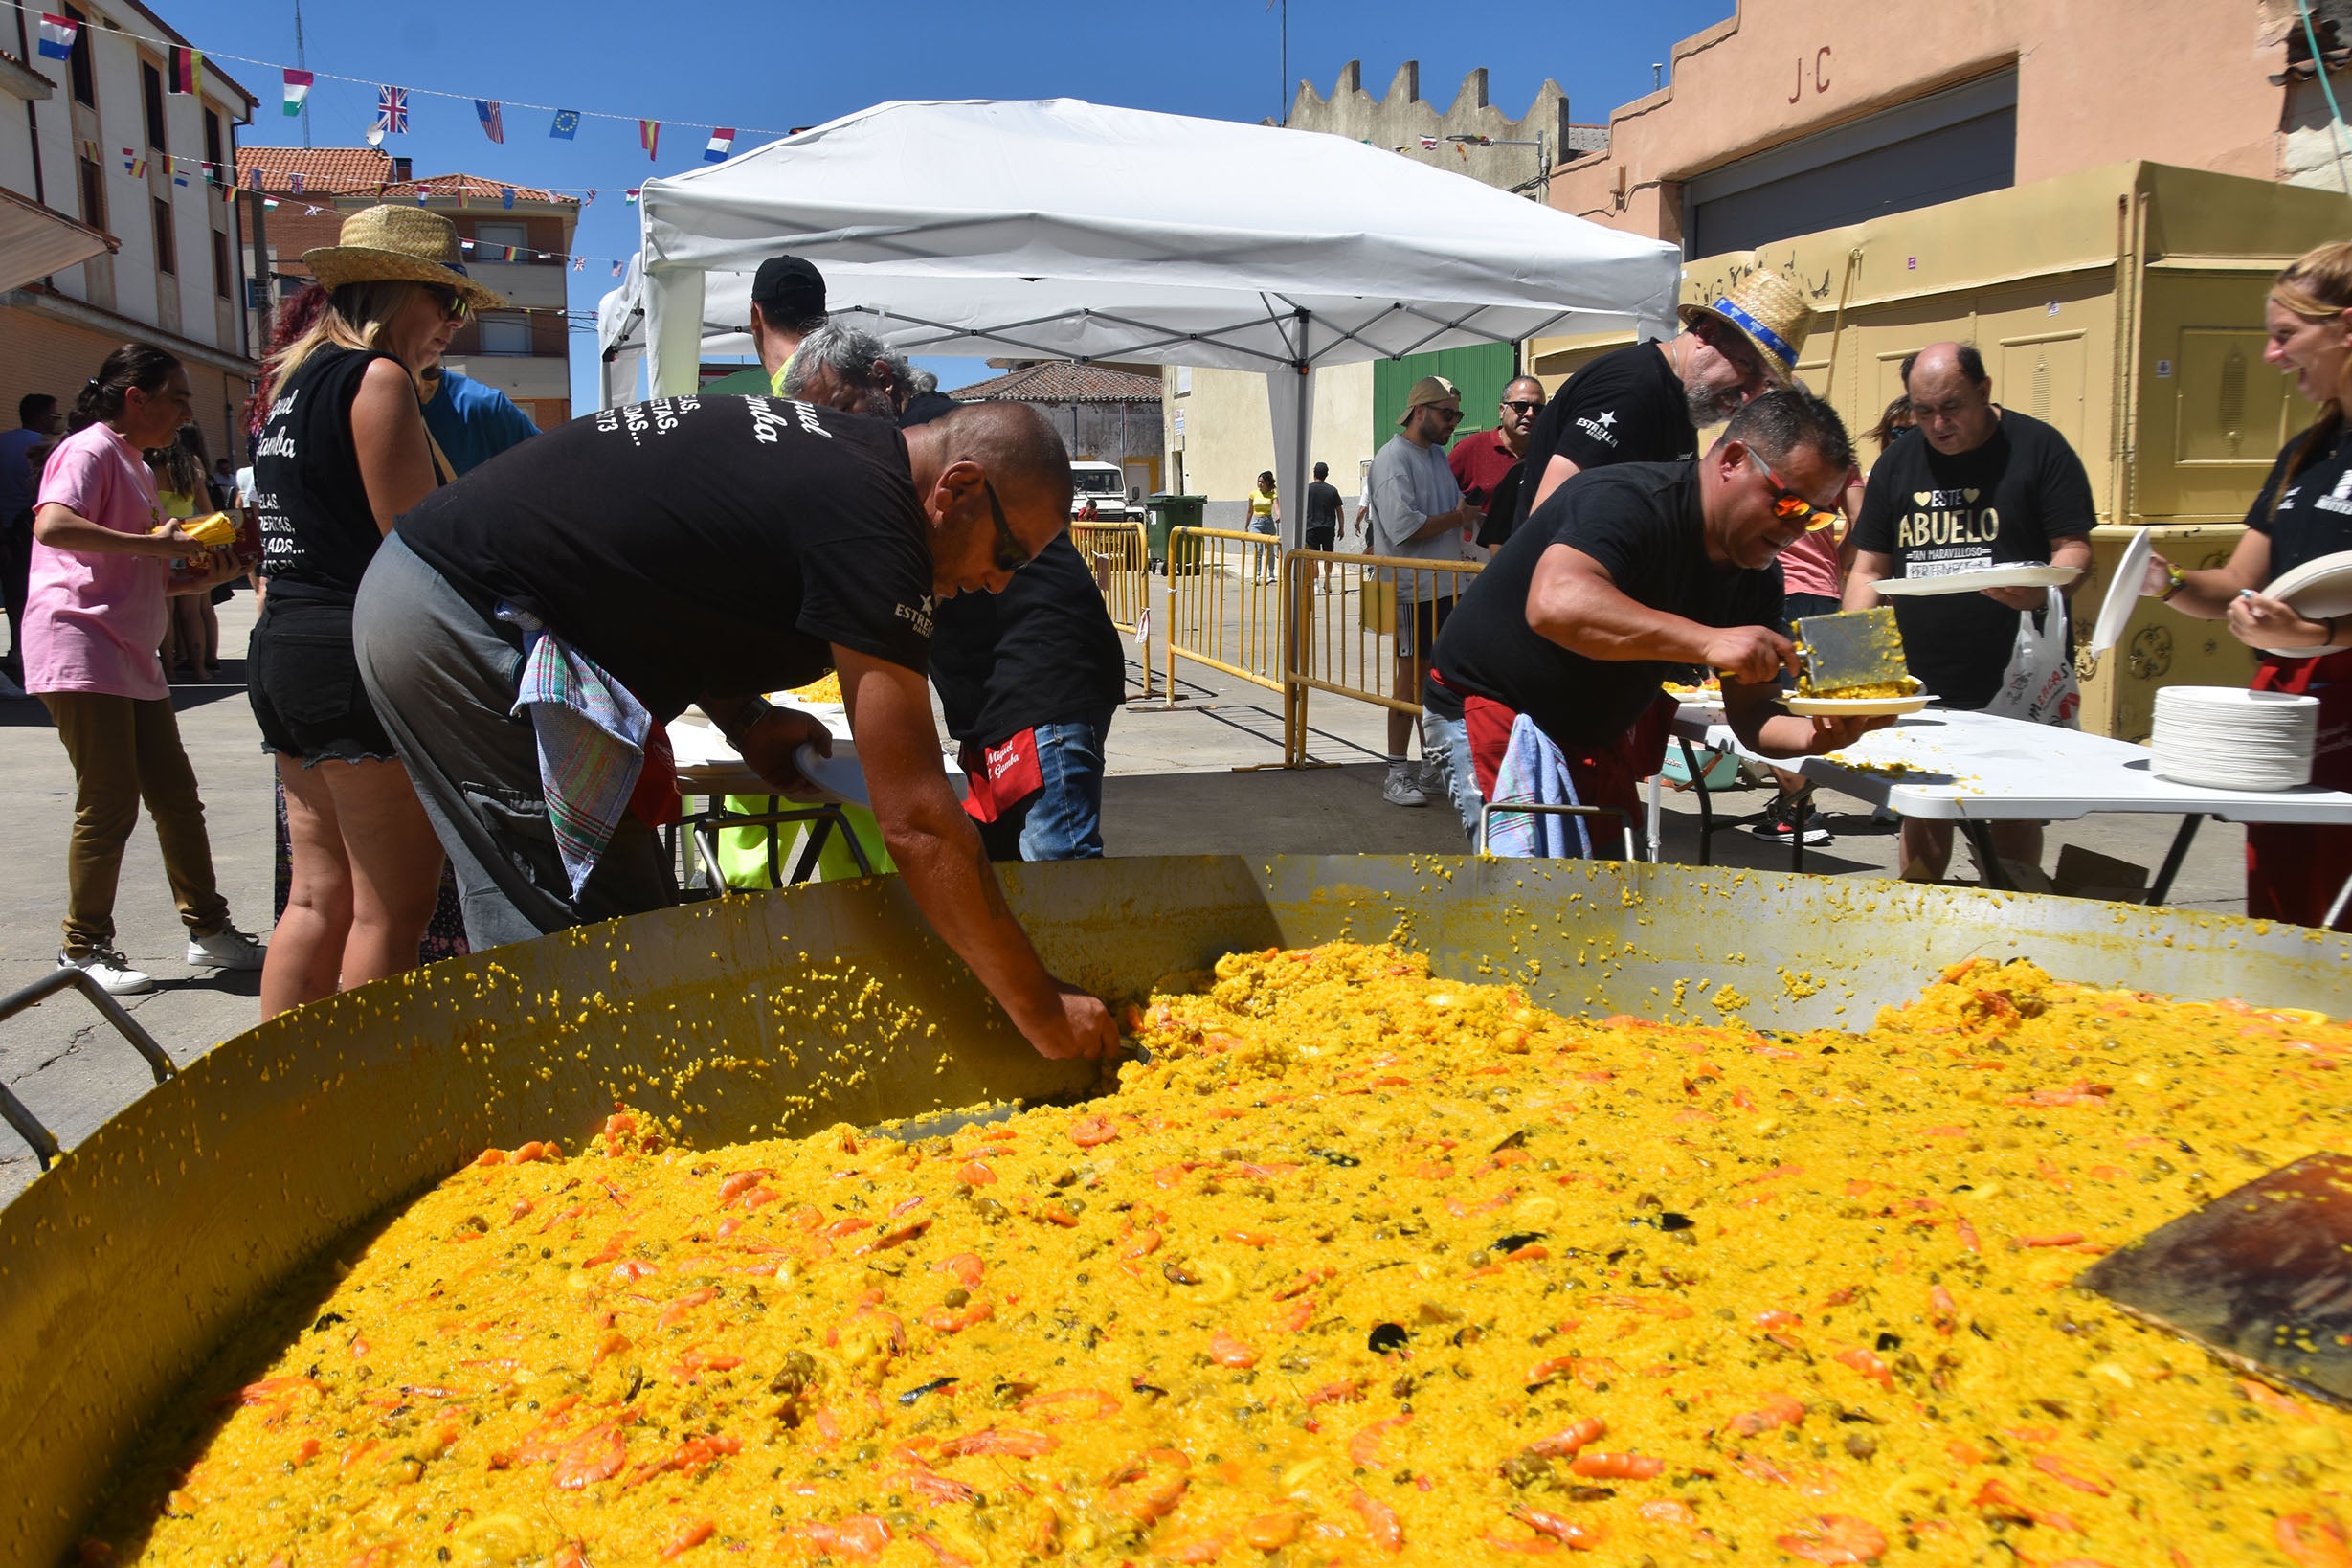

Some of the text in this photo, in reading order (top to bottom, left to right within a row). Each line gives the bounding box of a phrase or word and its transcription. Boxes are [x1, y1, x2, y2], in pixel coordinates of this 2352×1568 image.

[1575, 417, 1619, 448] ESTRELLA
[1931, 488, 1963, 507] ESTE
[1898, 507, 1999, 548] ABUELO
[1912, 547, 1982, 561] TAN MARAVILLOSO
[987, 740, 1014, 765] Miguel
[994, 753, 1019, 779] Gamba
